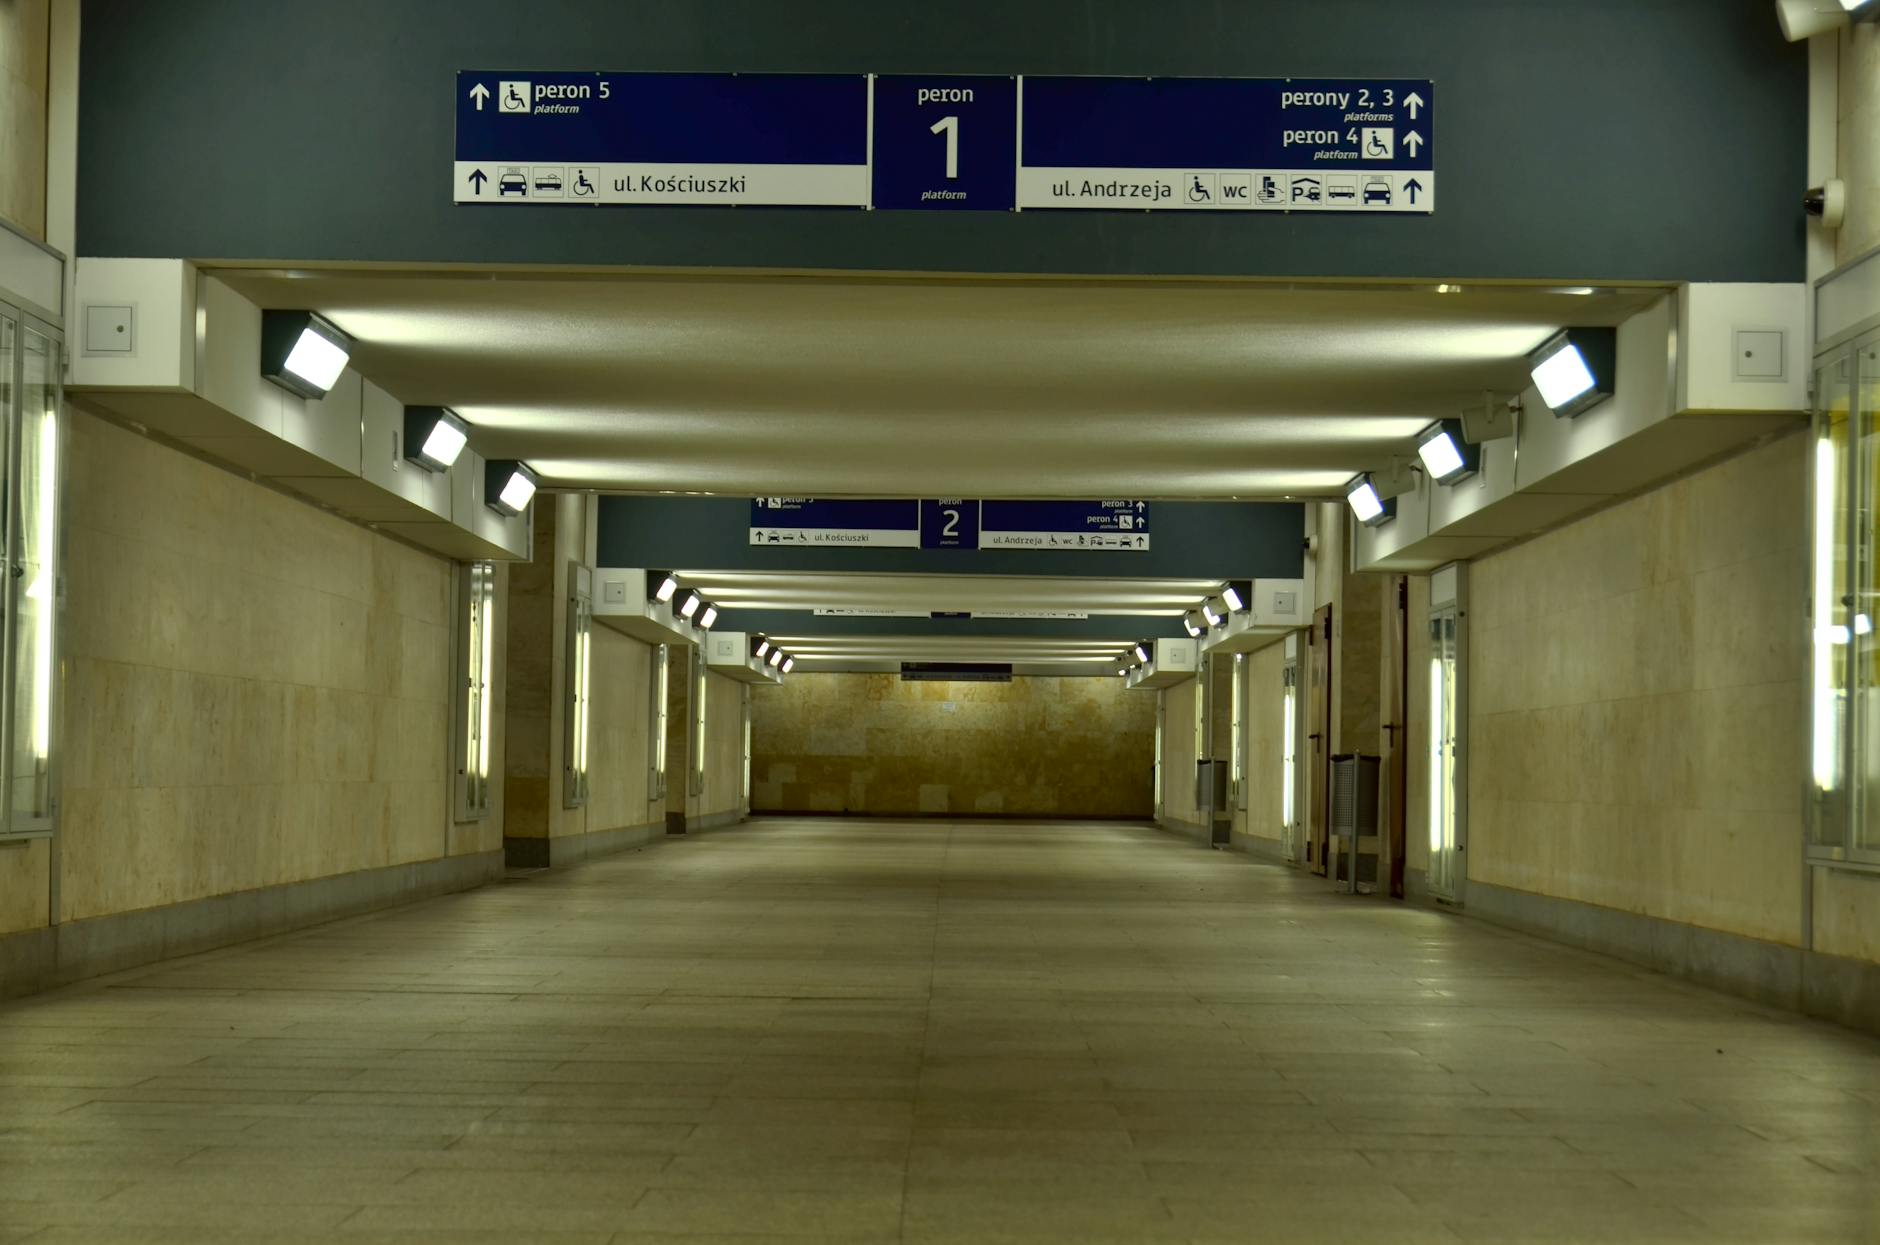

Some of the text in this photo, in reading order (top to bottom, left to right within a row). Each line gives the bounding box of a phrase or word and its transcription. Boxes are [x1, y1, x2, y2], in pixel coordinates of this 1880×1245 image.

[535, 82, 610, 102] peron 5
[918, 88, 974, 105] peron
[1281, 89, 1394, 109] perony 2, 3
[534, 103, 579, 115] platform
[1344, 111, 1394, 123] platforms
[1283, 127, 1358, 147] peron 4
[929, 116, 959, 179] 1
[1314, 150, 1358, 161] platform
[614, 174, 746, 193] ul. Kościuszki
[921, 190, 967, 201] platform
[1052, 180, 1172, 202] ul. Andrzeja
[938, 497, 962, 506] peron
[1101, 500, 1125, 508] peron
[942, 509, 960, 537] 2
[1087, 515, 1118, 524] peron 4
[826, 532, 869, 542] Kościuszki
[1005, 536, 1043, 546] Andrzeja
